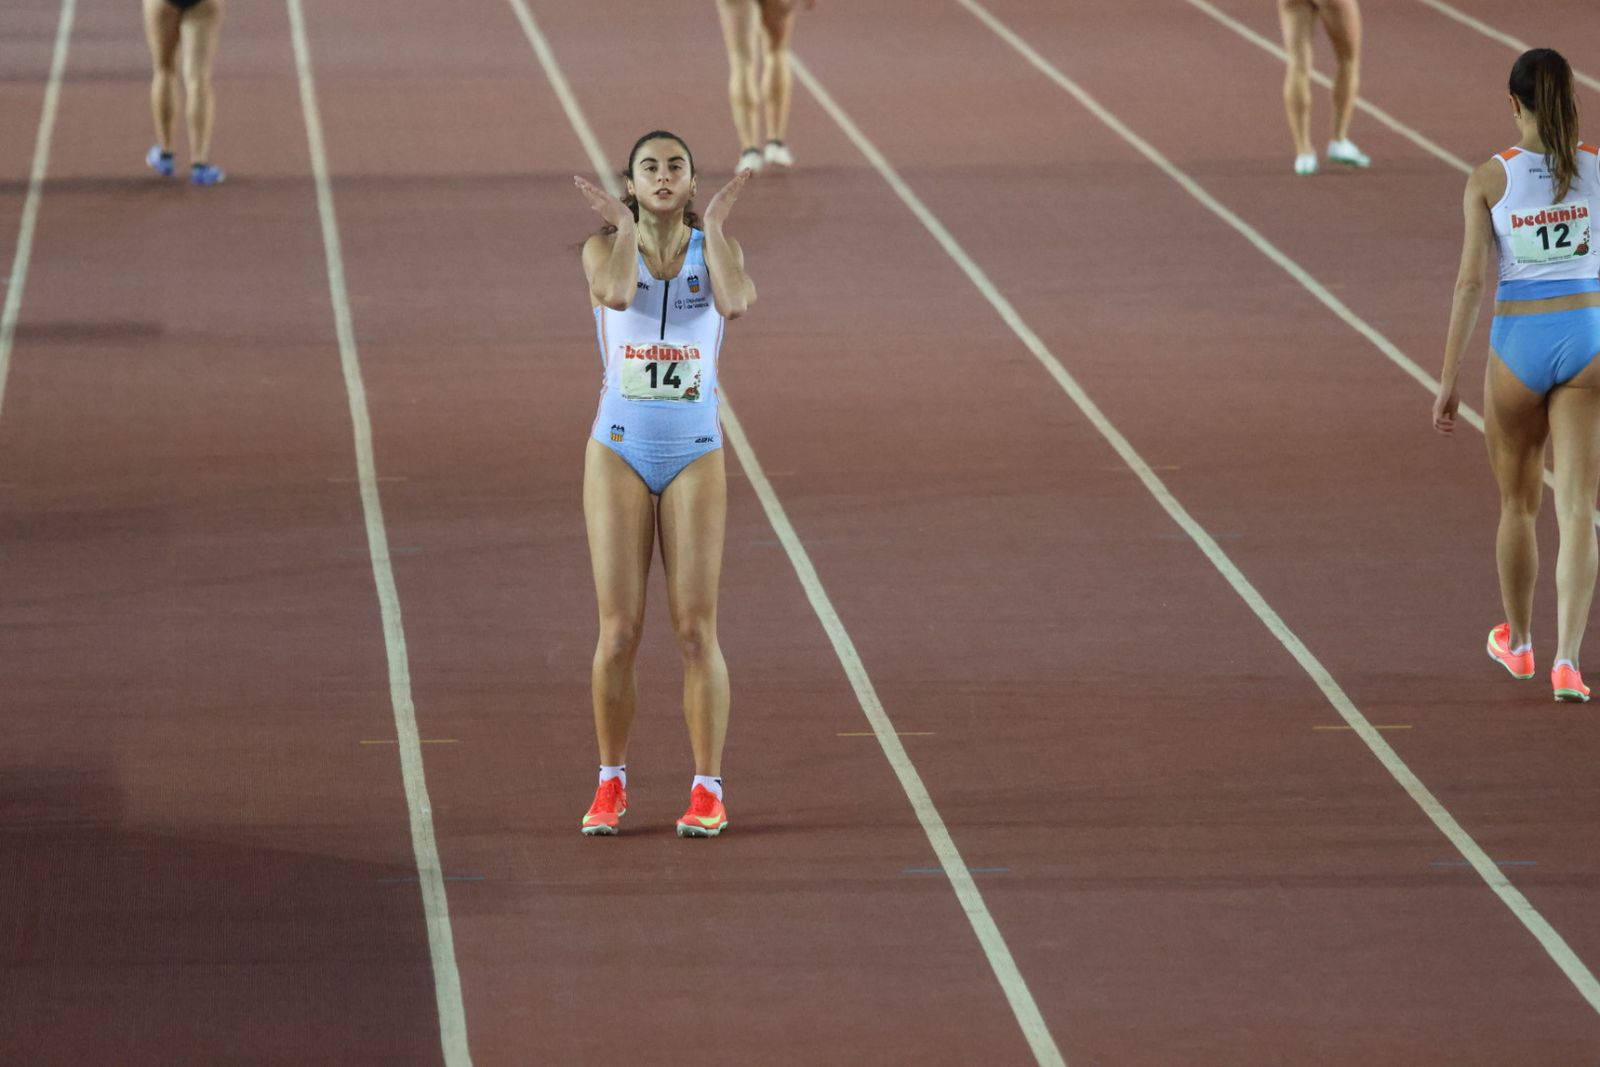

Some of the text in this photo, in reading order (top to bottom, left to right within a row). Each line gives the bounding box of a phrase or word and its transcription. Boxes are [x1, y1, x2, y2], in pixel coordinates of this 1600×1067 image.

[1511, 206, 1588, 229] bedunia
[1536, 222, 1571, 250] 12
[625, 345, 700, 361] bedunia
[645, 362, 681, 389] 14
